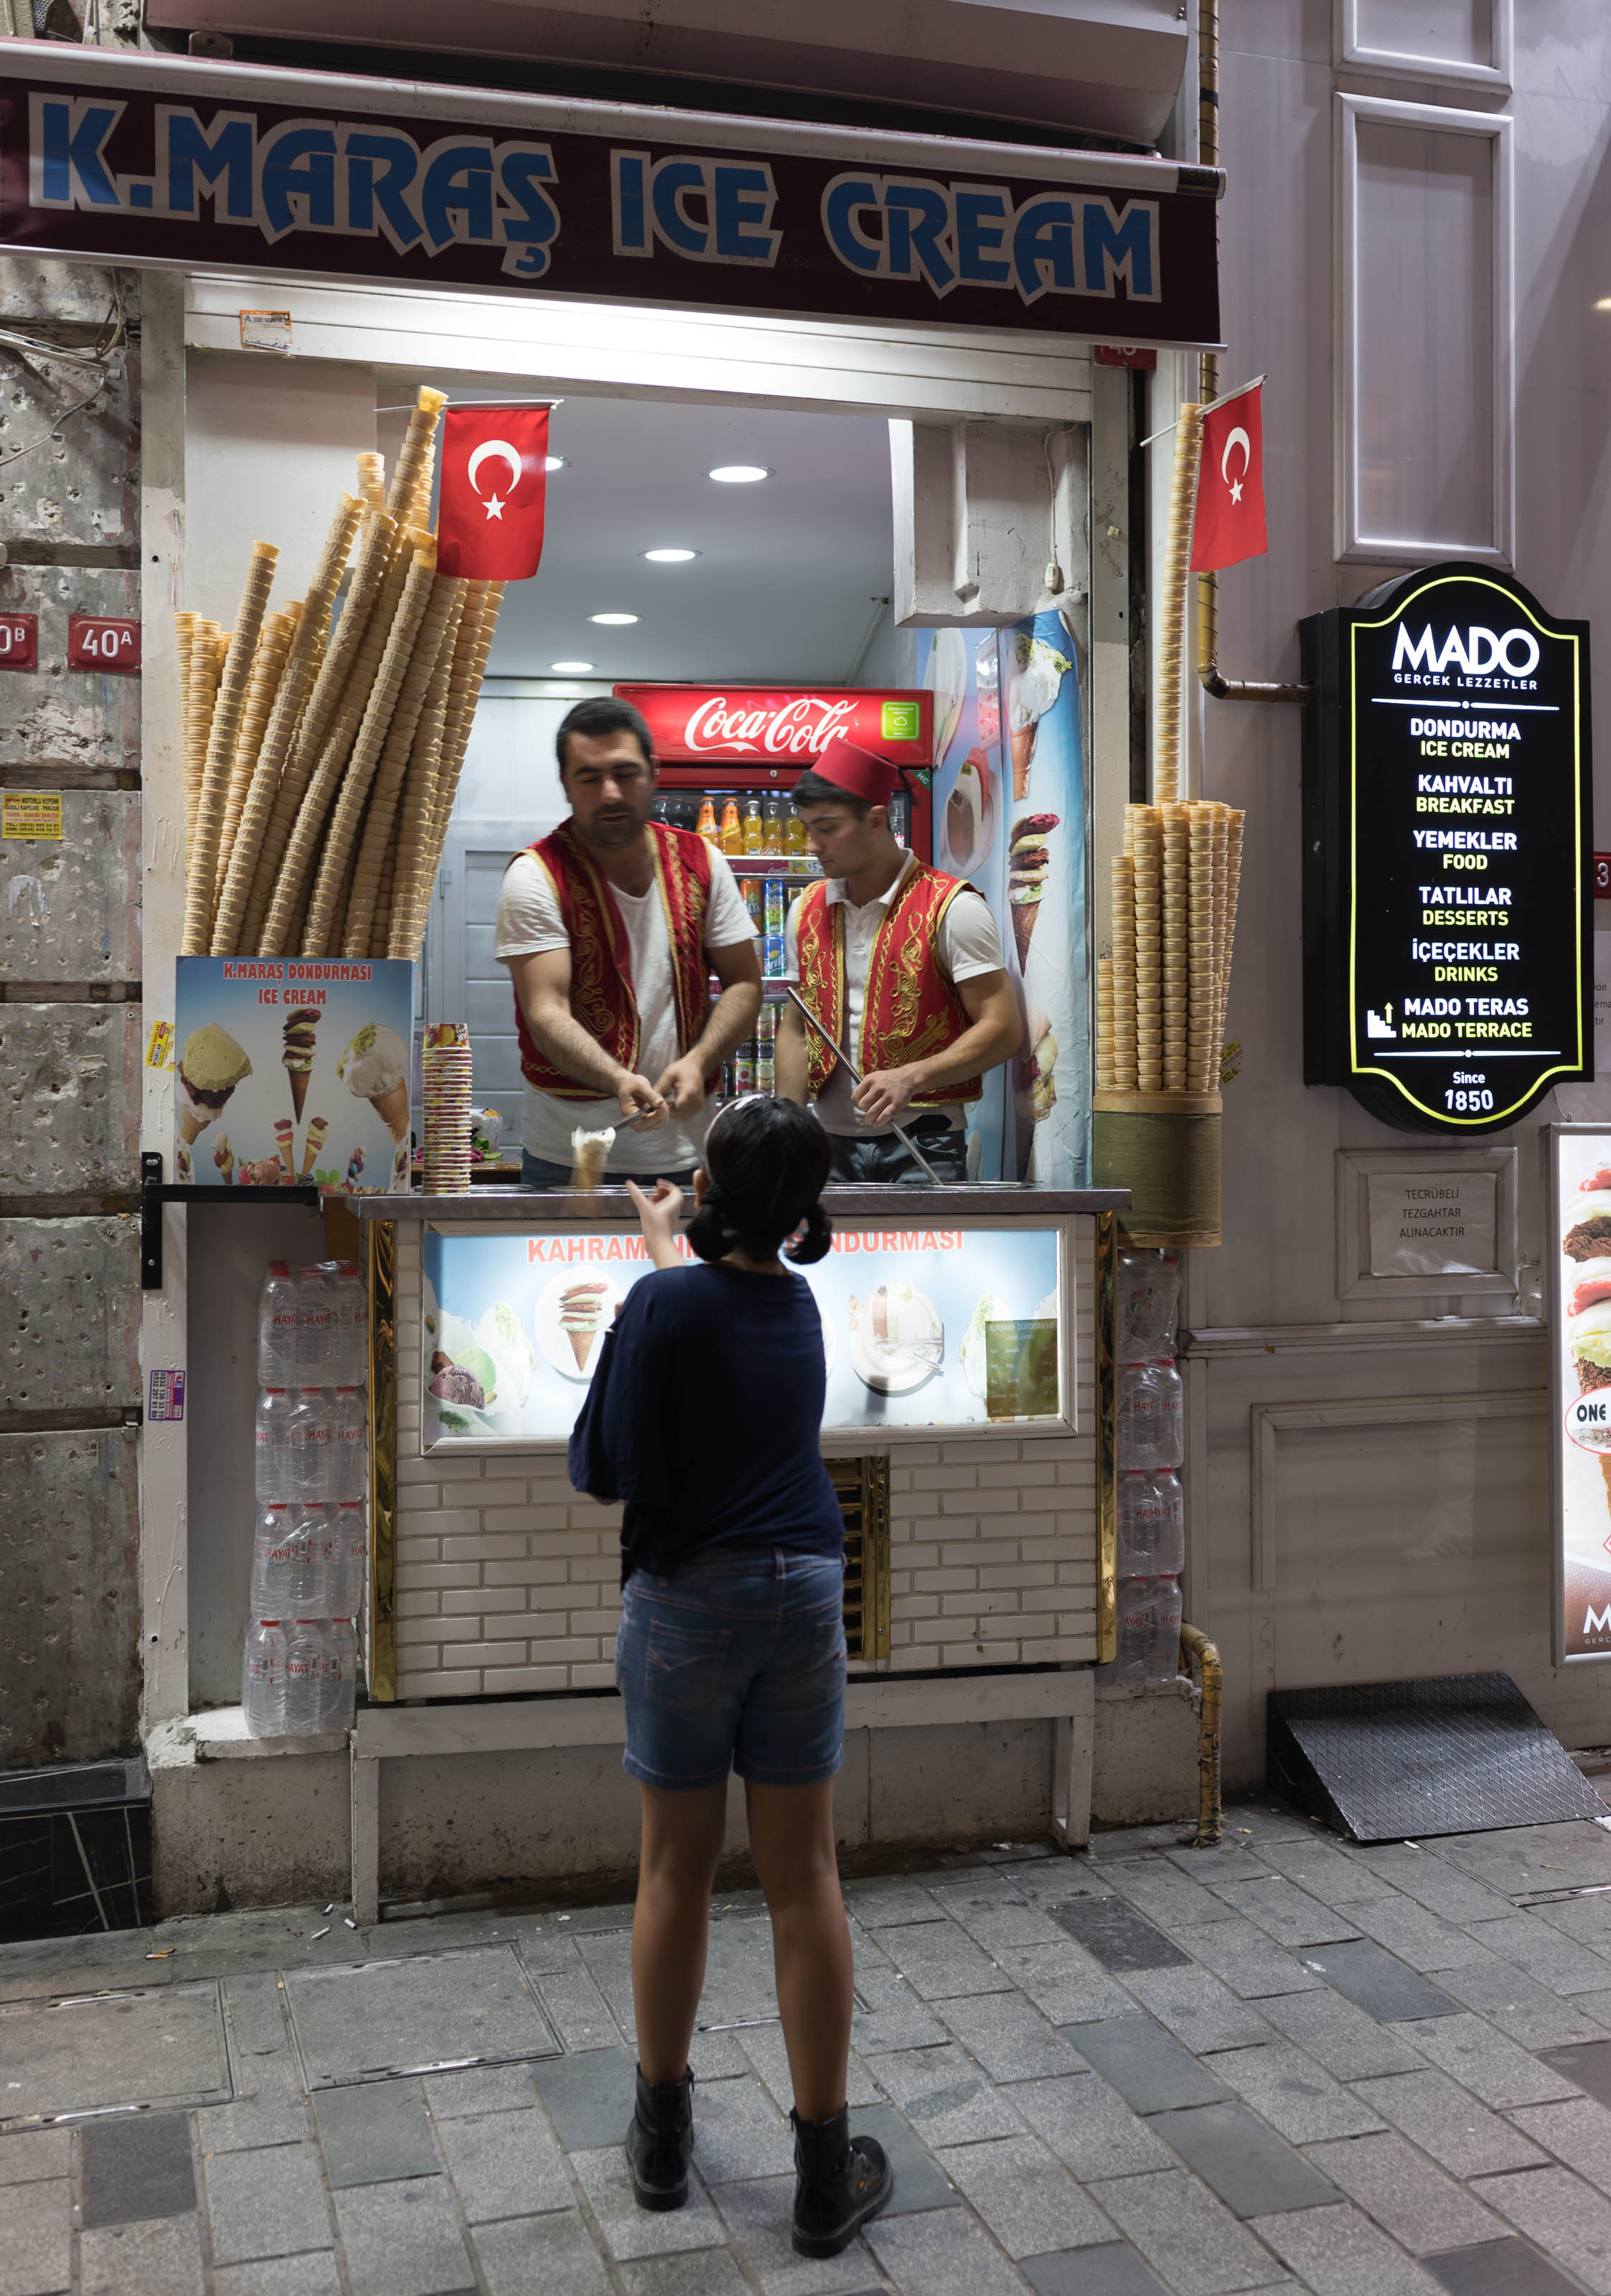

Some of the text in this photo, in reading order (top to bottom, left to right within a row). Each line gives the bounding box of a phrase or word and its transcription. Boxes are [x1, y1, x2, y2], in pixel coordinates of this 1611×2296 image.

[29, 91, 1162, 307] K.MARAŞ ICE CREAM
[0, 625, 25, 655] 0B
[1391, 621, 1540, 677] MADO
[1394, 673, 1538, 690] GERÇEK LEZZETLER
[1410, 718, 1521, 740] DONDURMA
[1421, 740, 1510, 758] ICE CREAM
[1418, 774, 1512, 795] KAHVALTI
[1416, 797, 1515, 814] BREAKFAST
[1413, 830, 1517, 850] YEMEKLER
[1442, 854, 1488, 870] FOOD
[1419, 886, 1511, 905] TATLILAR
[1422, 910, 1508, 926] DESSERTS
[1412, 938, 1520, 962] İÇEÇEKLER
[224, 962, 372, 984] K.MARAŞ DONDURMASI
[1434, 966, 1498, 982] DRINKS
[258, 988, 327, 1005] ICE CREAM
[1404, 998, 1529, 1016] MADO TERAS
[1402, 1022, 1533, 1038] MADO TERRACE
[1452, 1072, 1485, 1084] Since
[1445, 1089, 1494, 1111] 1850
[1406, 1187, 1460, 1200] TECRÜBELİ
[1402, 1207, 1461, 1218] TEZGAHTAR
[1399, 1226, 1465, 1239] ALINACAKTIR
[786, 1230, 964, 1254] NDURMASI
[1577, 1403, 1607, 1423] ONE
